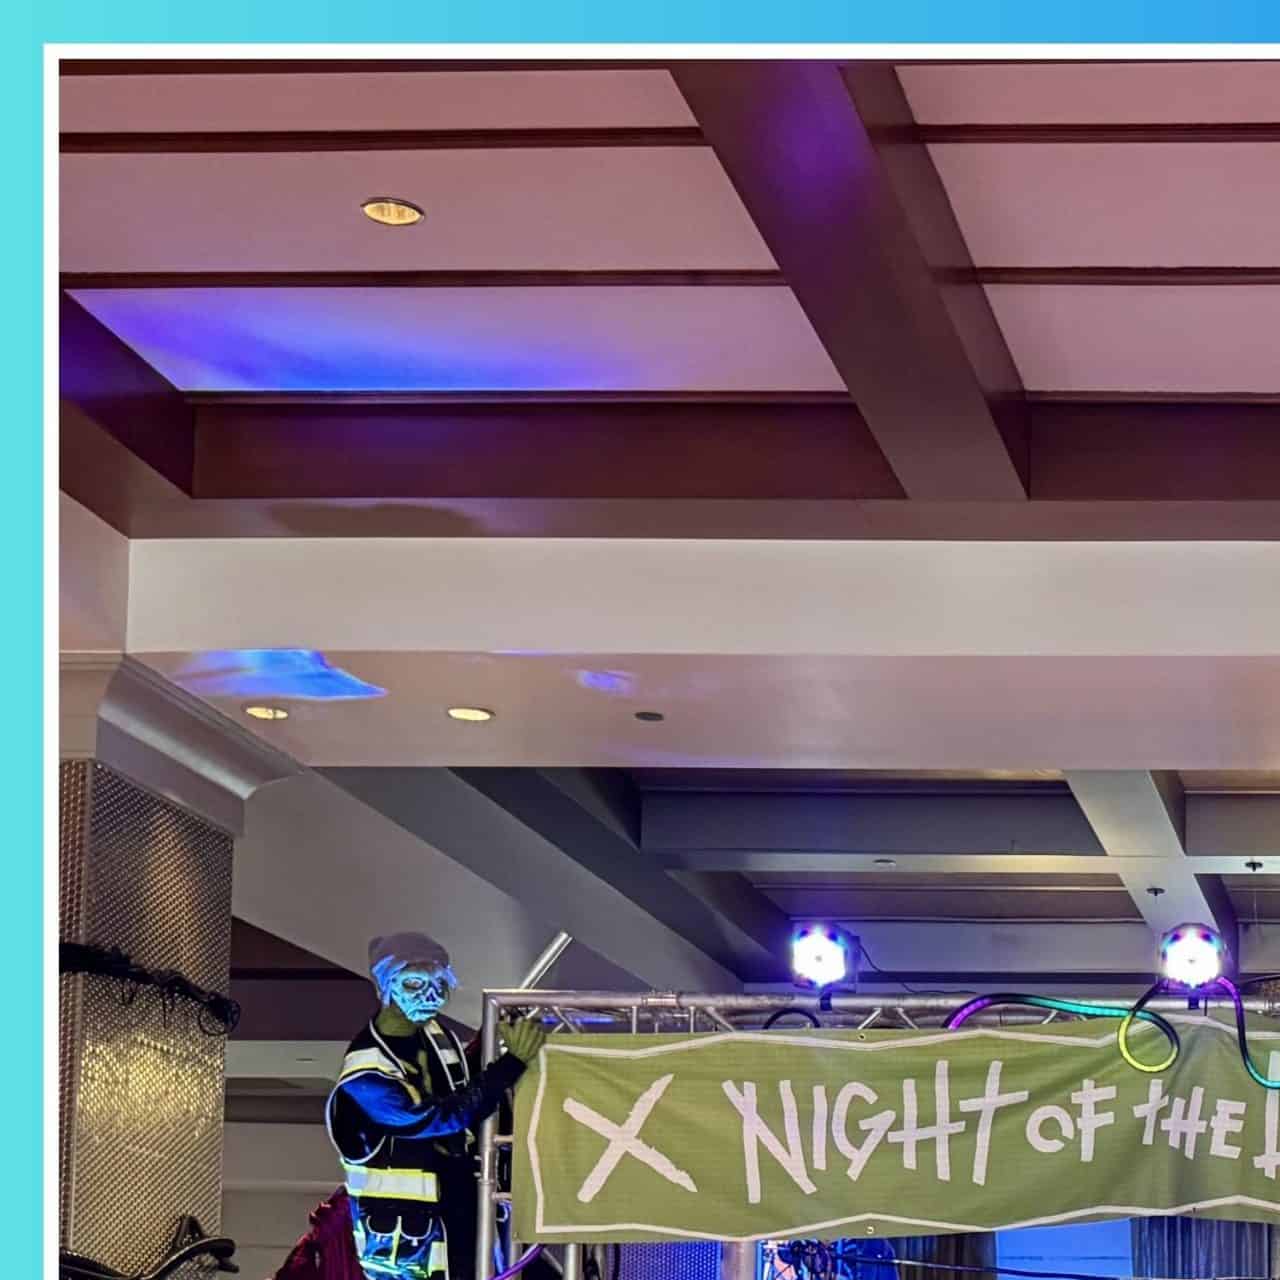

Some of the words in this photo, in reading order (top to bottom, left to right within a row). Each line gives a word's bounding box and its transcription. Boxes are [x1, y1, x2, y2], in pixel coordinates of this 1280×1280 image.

[723, 1061, 1028, 1203] NIGHT
[1026, 1079, 1115, 1162] OF
[1133, 1079, 1245, 1159] THE
